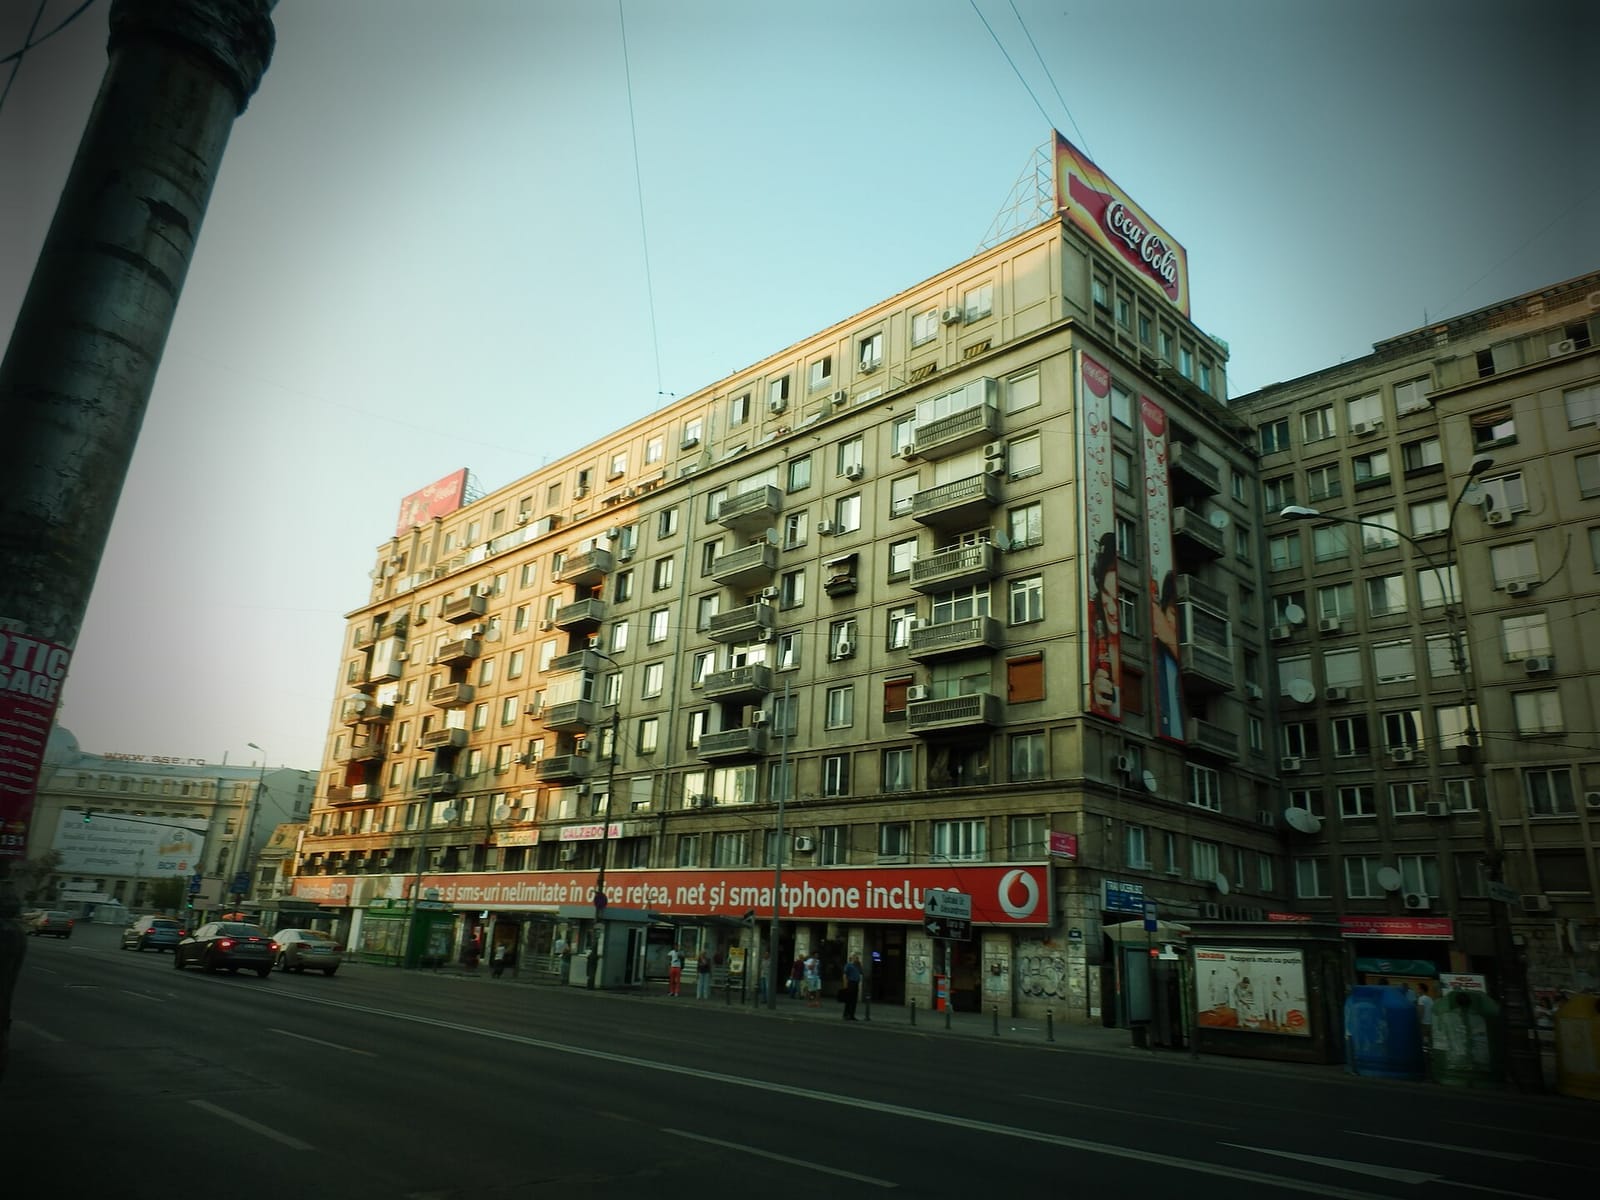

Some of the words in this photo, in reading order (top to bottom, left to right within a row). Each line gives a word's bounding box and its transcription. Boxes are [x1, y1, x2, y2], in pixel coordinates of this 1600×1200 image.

[457, 881, 500, 902] sms-uri
[503, 880, 567, 903] nelimitate
[569, 879, 583, 903] în
[587, 882, 621, 904] oice
[626, 883, 672, 910] rețea,
[676, 882, 705, 906] net
[709, 881, 725, 911] și
[866, 880, 961, 909] inclu
